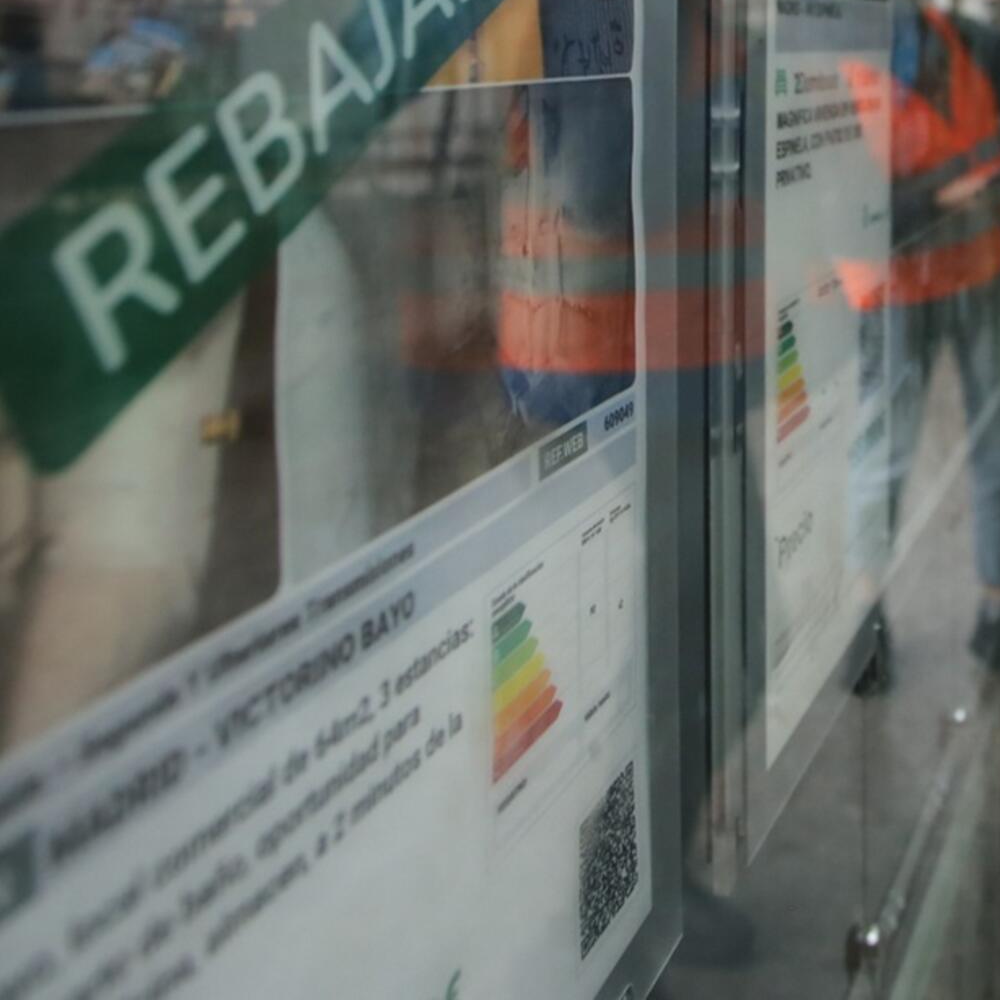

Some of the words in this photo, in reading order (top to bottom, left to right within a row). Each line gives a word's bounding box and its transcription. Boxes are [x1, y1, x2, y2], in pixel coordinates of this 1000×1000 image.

[603, 401, 634, 432] 609049
[215, 632, 357, 748] VICTORINO
[358, 590, 416, 652] BAYO
[281, 749, 309, 787] de
[379, 680, 392, 709] 3
[394, 617, 475, 697] estancias:
[256, 742, 381, 860] oportunidad
[383, 706, 422, 757] para
[348, 746, 423, 825] minutos
[424, 725, 446, 759] de
[447, 708, 464, 740] la
